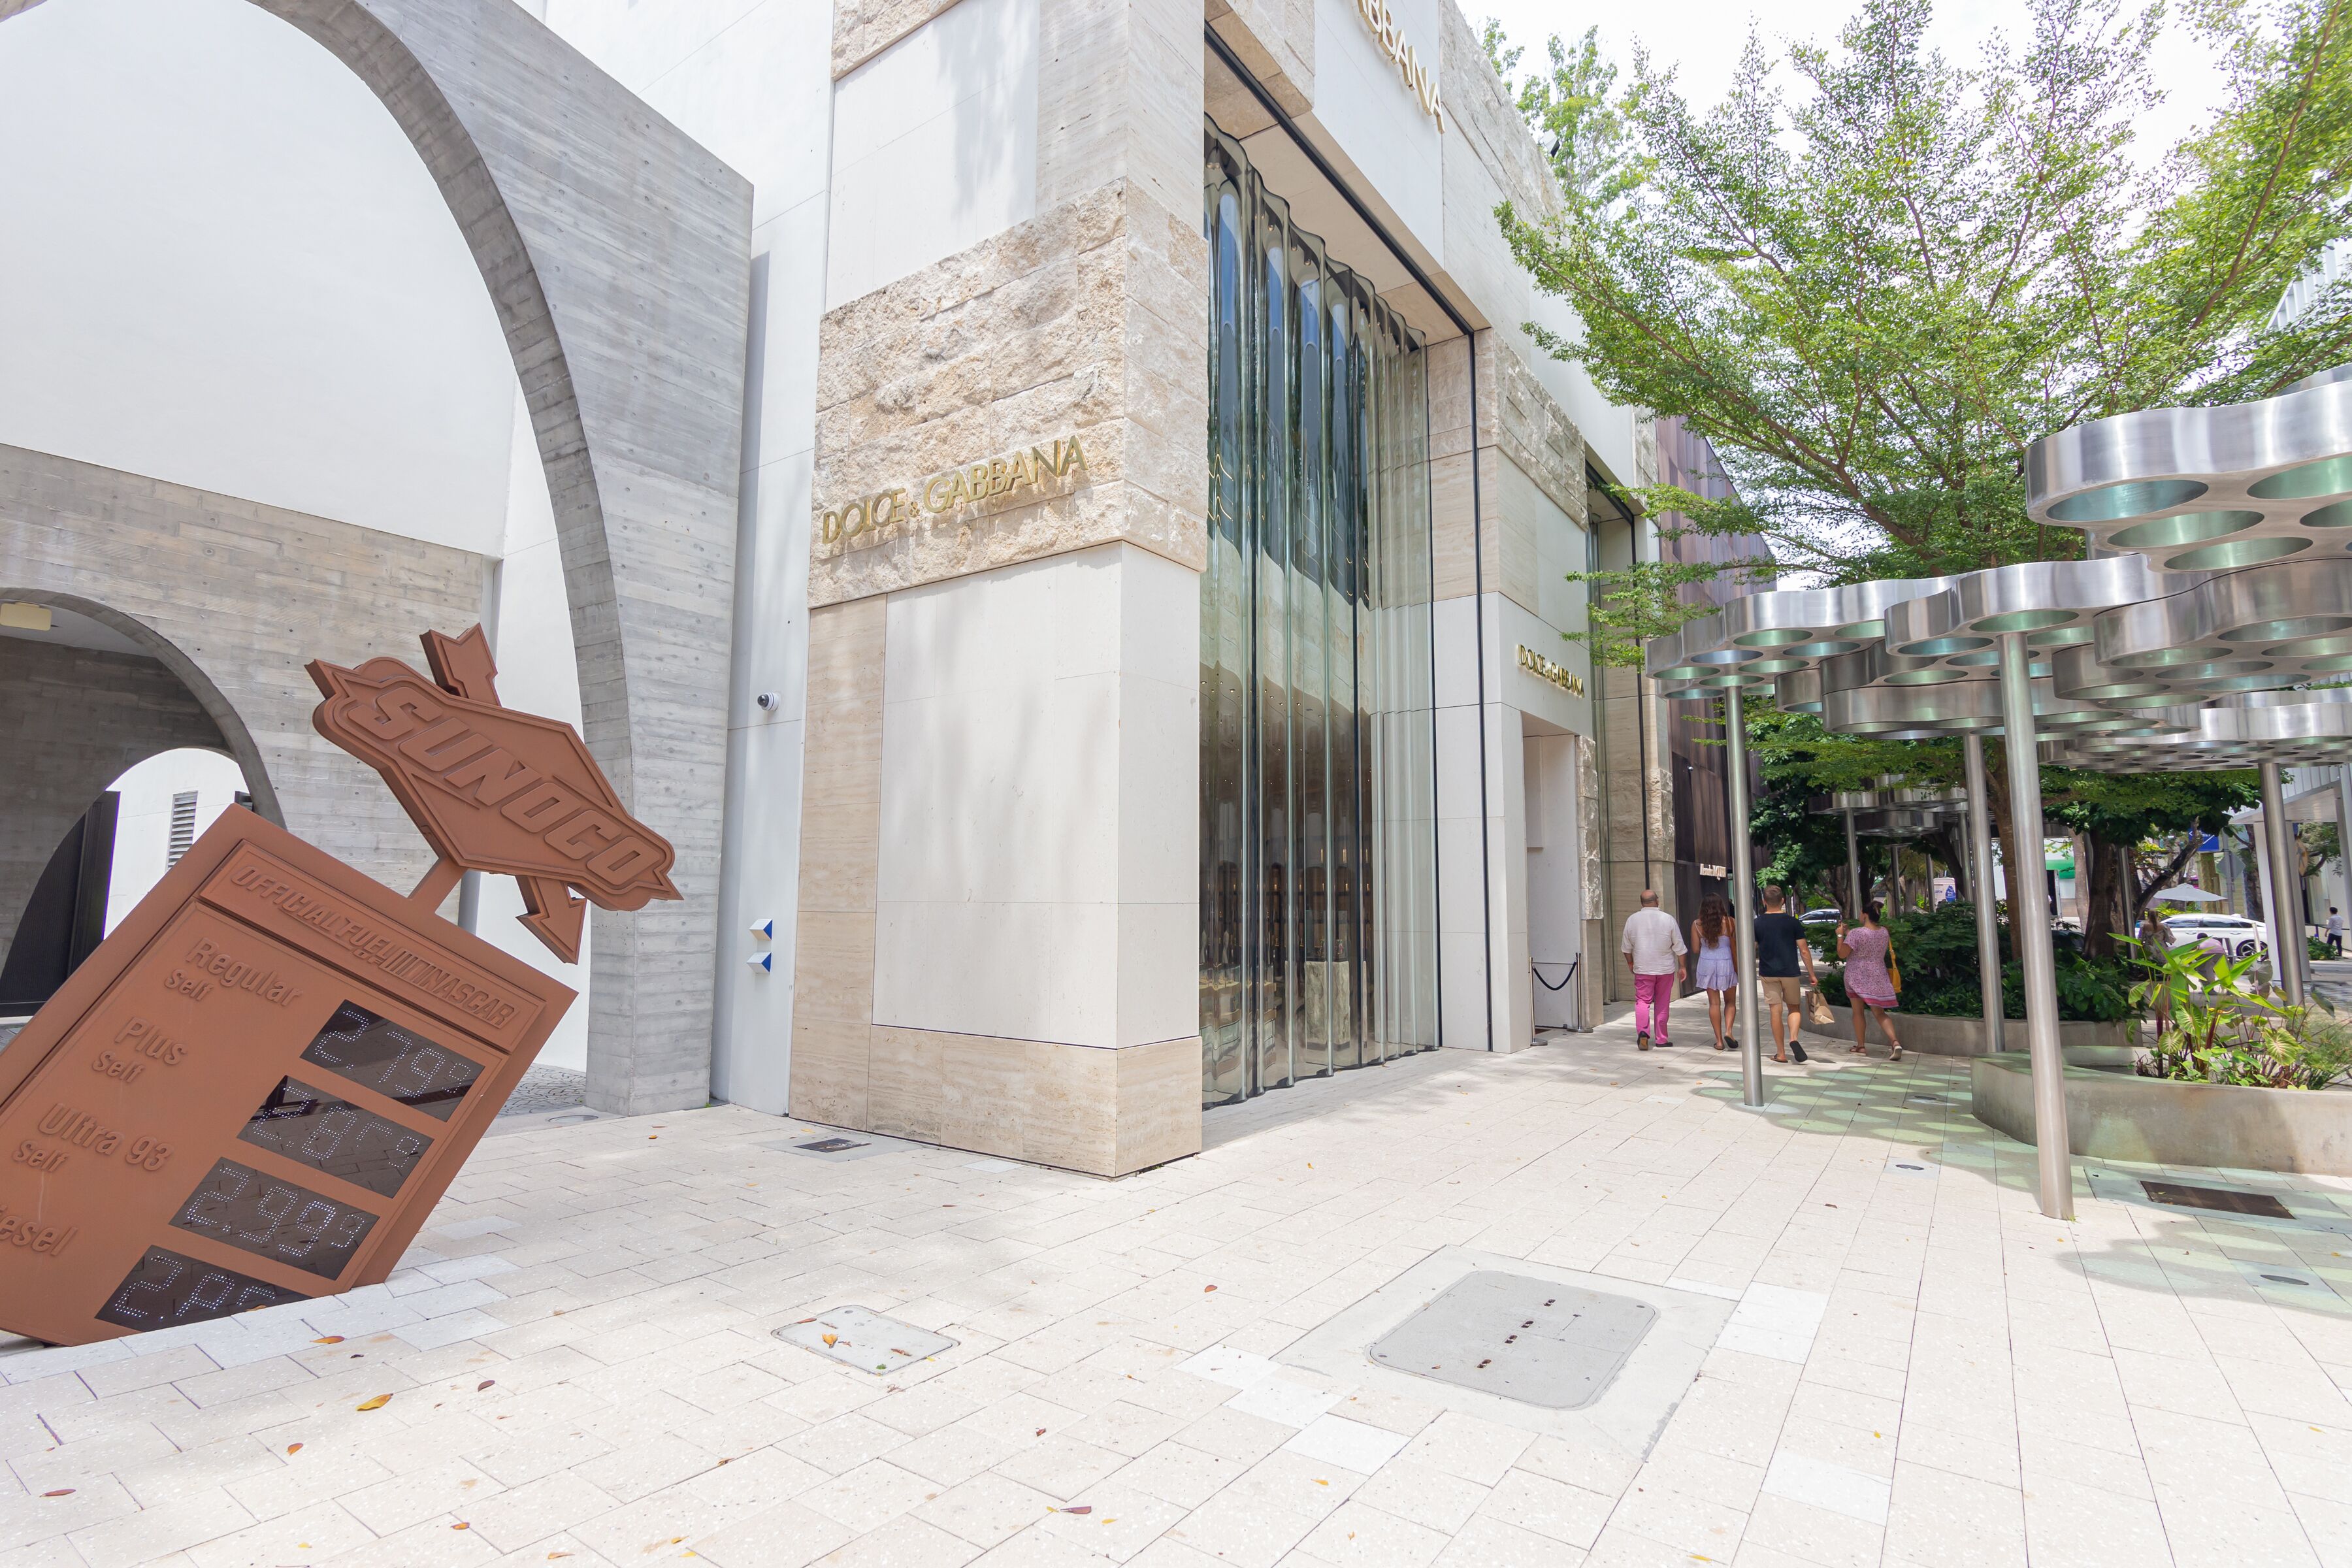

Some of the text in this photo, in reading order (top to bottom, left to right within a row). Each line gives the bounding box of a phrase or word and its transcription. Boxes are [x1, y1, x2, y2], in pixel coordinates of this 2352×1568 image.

[1358, 0, 1445, 135] BBANA
[821, 434, 1090, 545] DOLCE & GABBANA
[1516, 644, 1546, 677] DOLCE
[346, 686, 661, 886] SUNOCO
[231, 865, 397, 960] OFFICIAL FUEL
[164, 969, 214, 1002] Self
[186, 937, 304, 1007] Regular
[419, 968, 515, 1026] NASCAR
[93, 1050, 145, 1083] Self
[114, 1017, 188, 1066] Plus
[12, 1140, 69, 1172] Self
[38, 1103, 174, 1171] Ultra 93
[0, 1204, 78, 1256] esel
